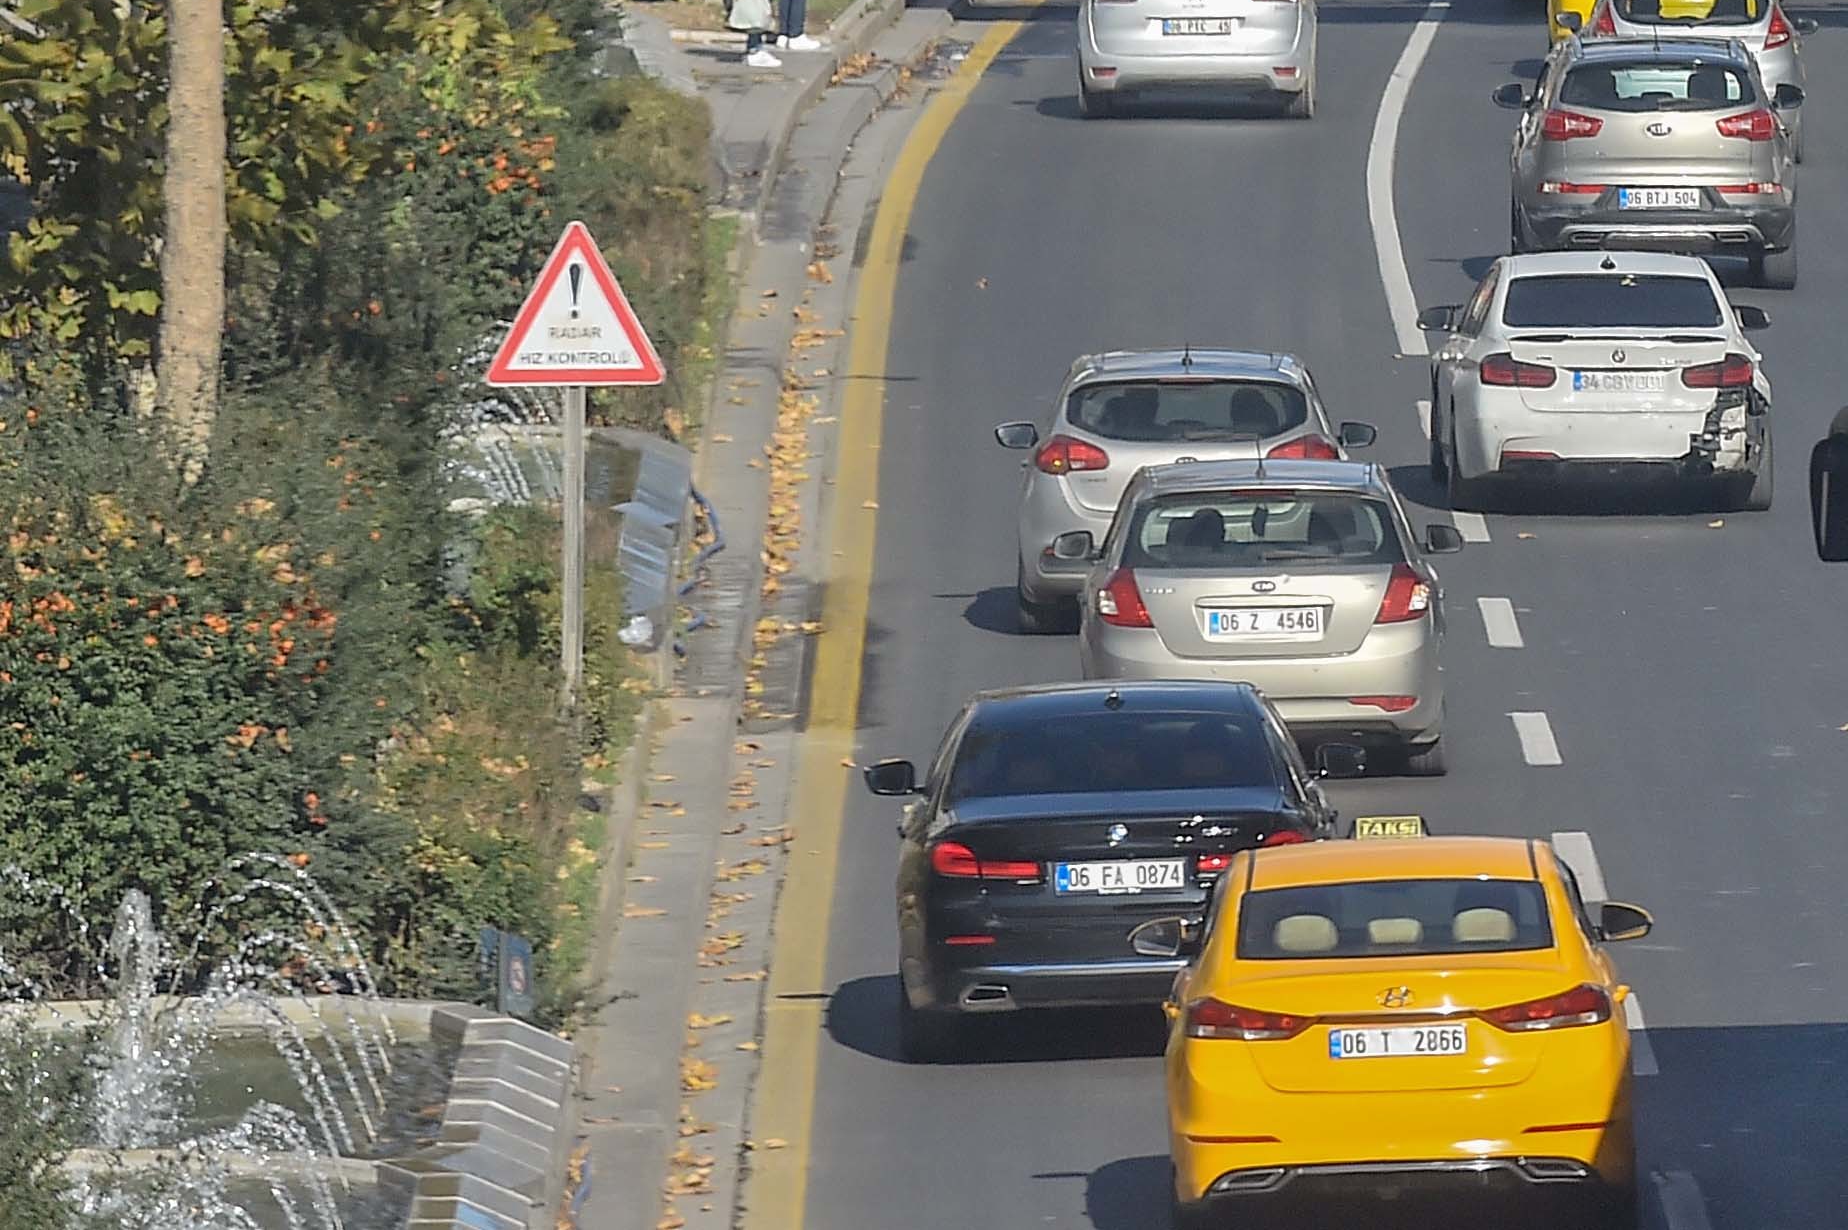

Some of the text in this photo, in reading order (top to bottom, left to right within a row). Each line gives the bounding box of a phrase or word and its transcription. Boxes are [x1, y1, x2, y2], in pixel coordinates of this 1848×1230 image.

[1627, 192, 1642, 205] 06
[1675, 192, 1697, 205] 504
[549, 326, 602, 339] RADAR
[520, 353, 545, 365] HIZ
[1220, 611, 1316, 631] 06 Z 4546
[1069, 864, 1180, 887] 06 FA 0874
[1342, 1029, 1463, 1054] 06 T 2866
